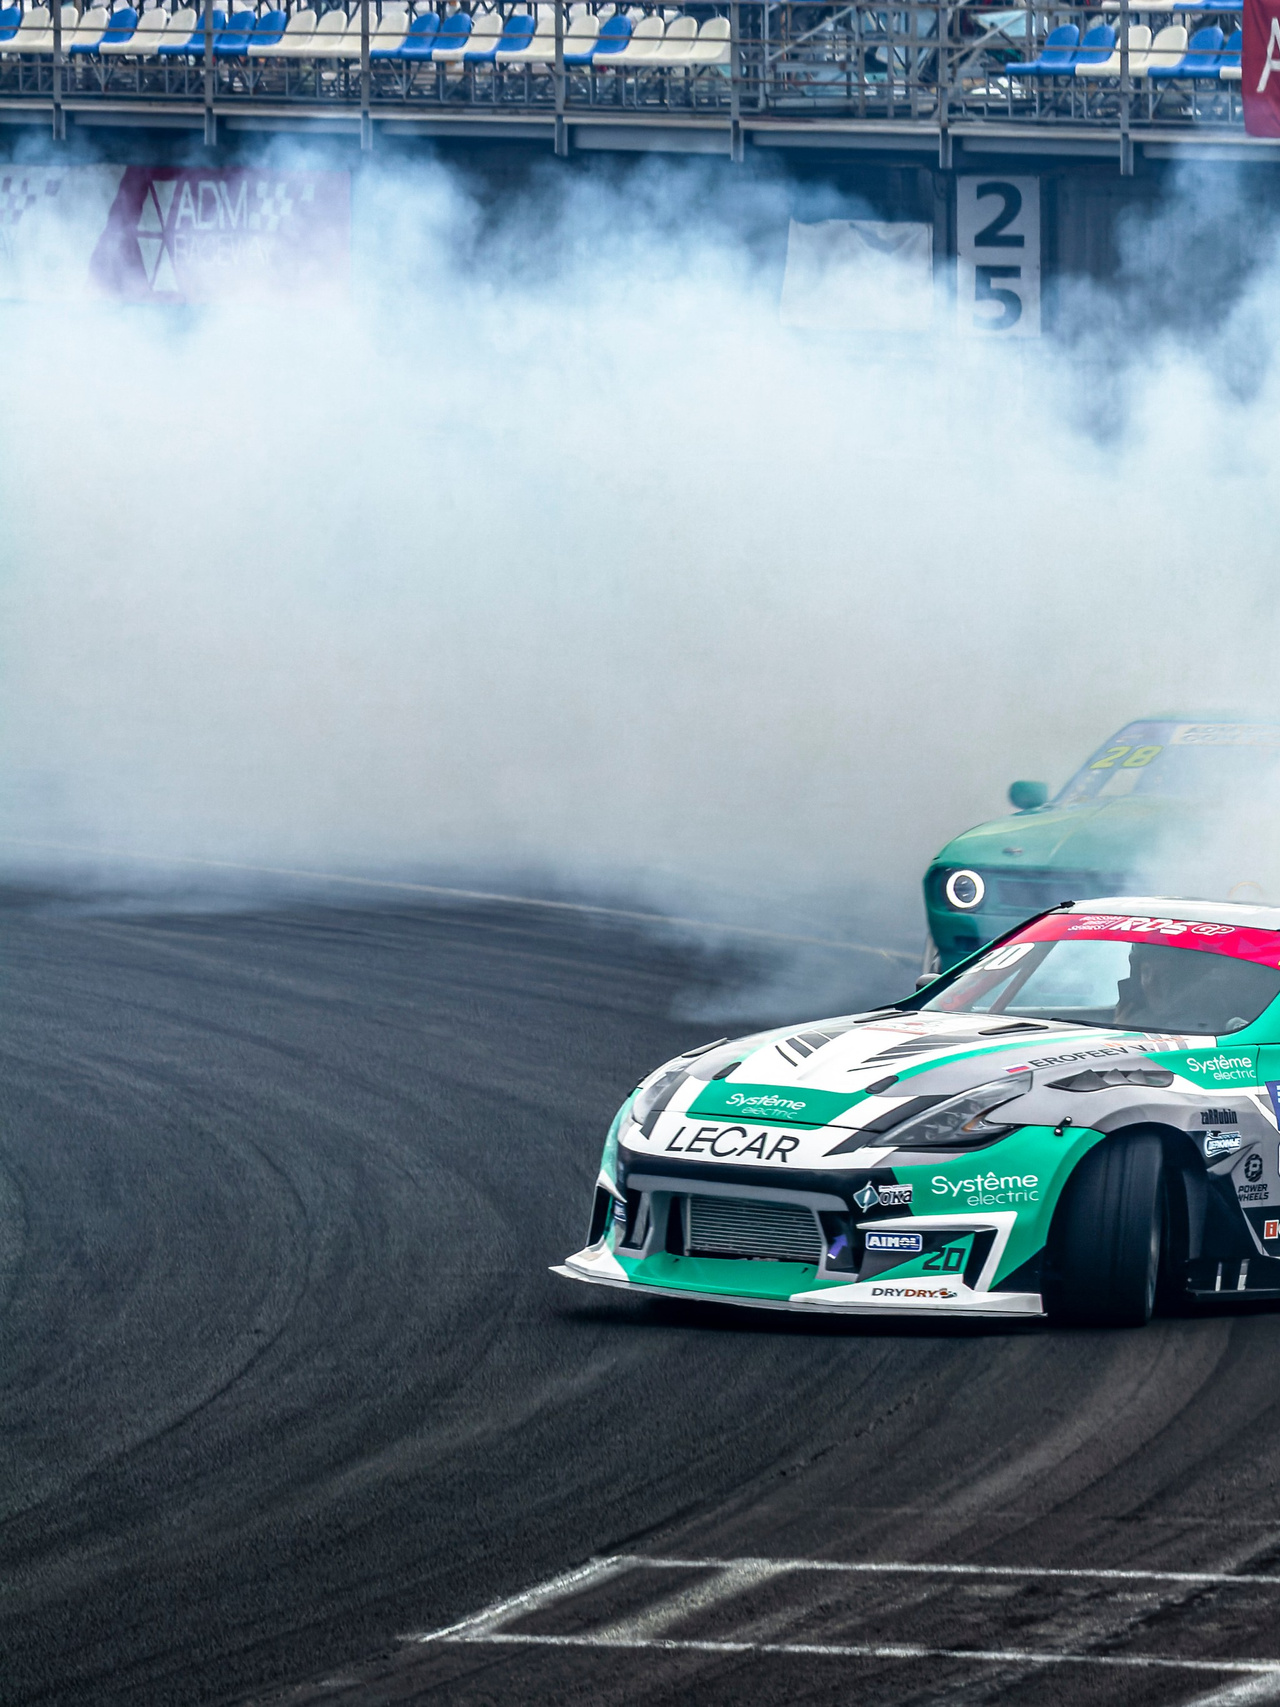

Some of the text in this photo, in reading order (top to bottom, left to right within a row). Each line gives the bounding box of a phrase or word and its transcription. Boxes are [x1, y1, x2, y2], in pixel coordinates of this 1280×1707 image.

[175, 180, 248, 230] ADM
[1089, 745, 1164, 770] 28
[1028, 1046, 1129, 1068] EROFEEV
[1186, 1054, 1253, 1074] Système
[1213, 1068, 1257, 1081] electric
[725, 1092, 807, 1111] Système
[741, 1105, 798, 1119] electric
[664, 1125, 800, 1163] LECAR
[931, 1171, 1039, 1197] Système
[1238, 1183, 1268, 1193] POWER
[966, 1189, 1040, 1207] electric
